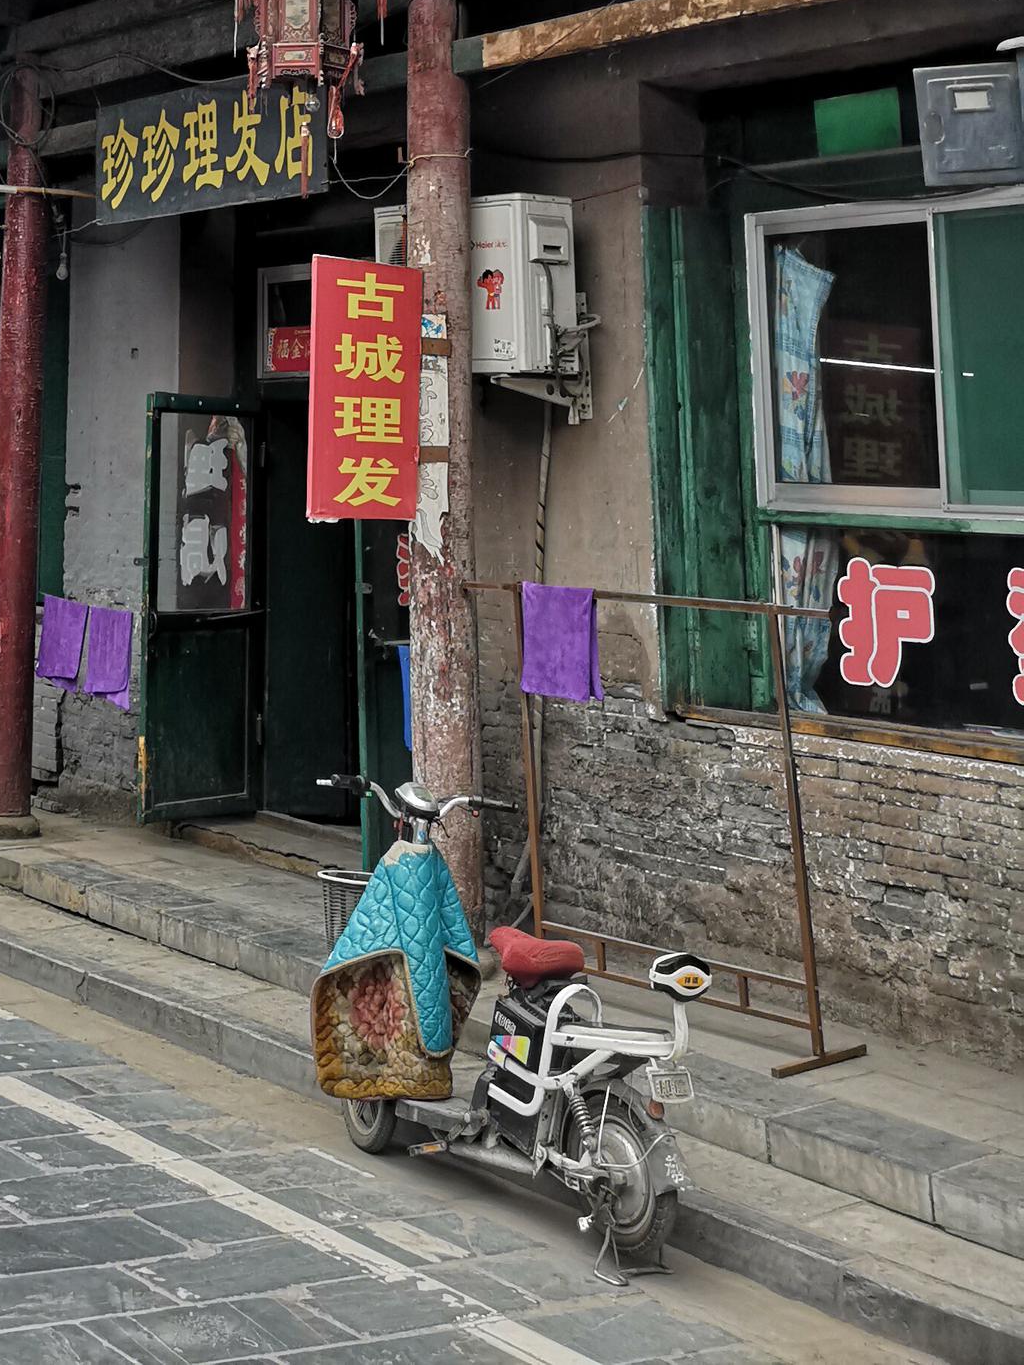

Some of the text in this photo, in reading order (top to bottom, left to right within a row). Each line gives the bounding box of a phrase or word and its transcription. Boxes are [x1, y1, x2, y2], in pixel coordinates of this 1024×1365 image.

[100, 84, 314, 210] 珍珍理发店
[333, 271, 406, 508] 古城理发
[837, 557, 936, 689] 护
